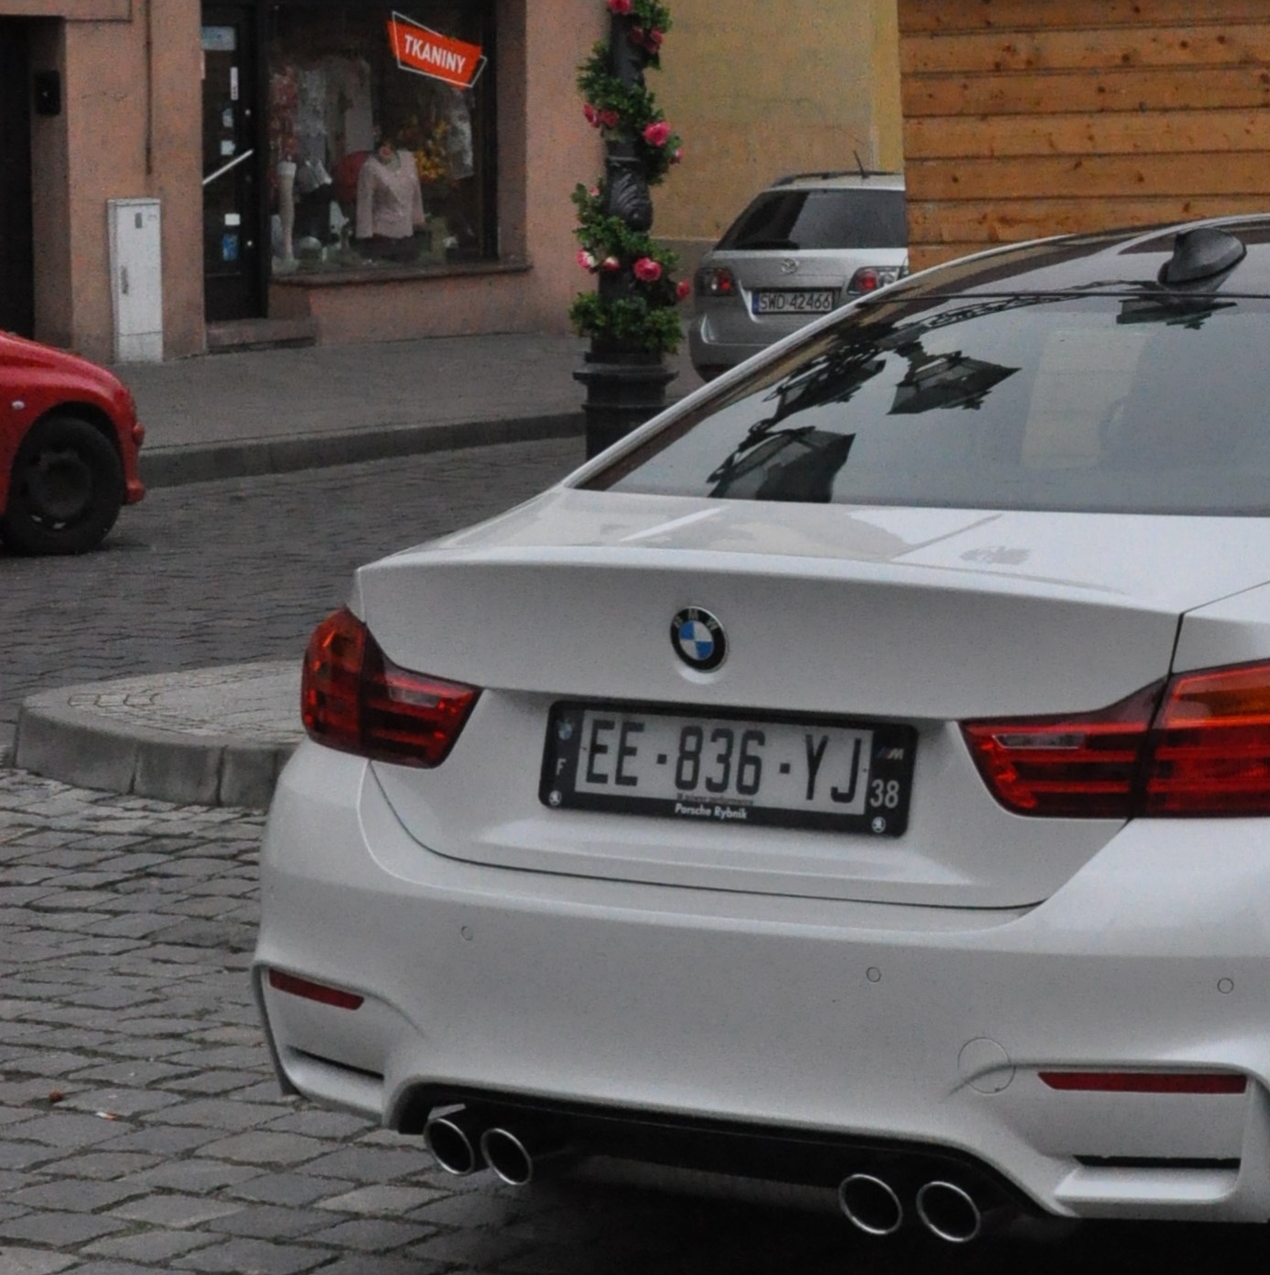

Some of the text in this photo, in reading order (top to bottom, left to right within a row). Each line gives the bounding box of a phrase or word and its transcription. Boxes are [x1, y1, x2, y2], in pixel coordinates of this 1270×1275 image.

[403, 34, 467, 74] TKANINY
[789, 294, 831, 310] 42466
[869, 779, 900, 809] 38
[675, 803, 712, 817] Porsche
